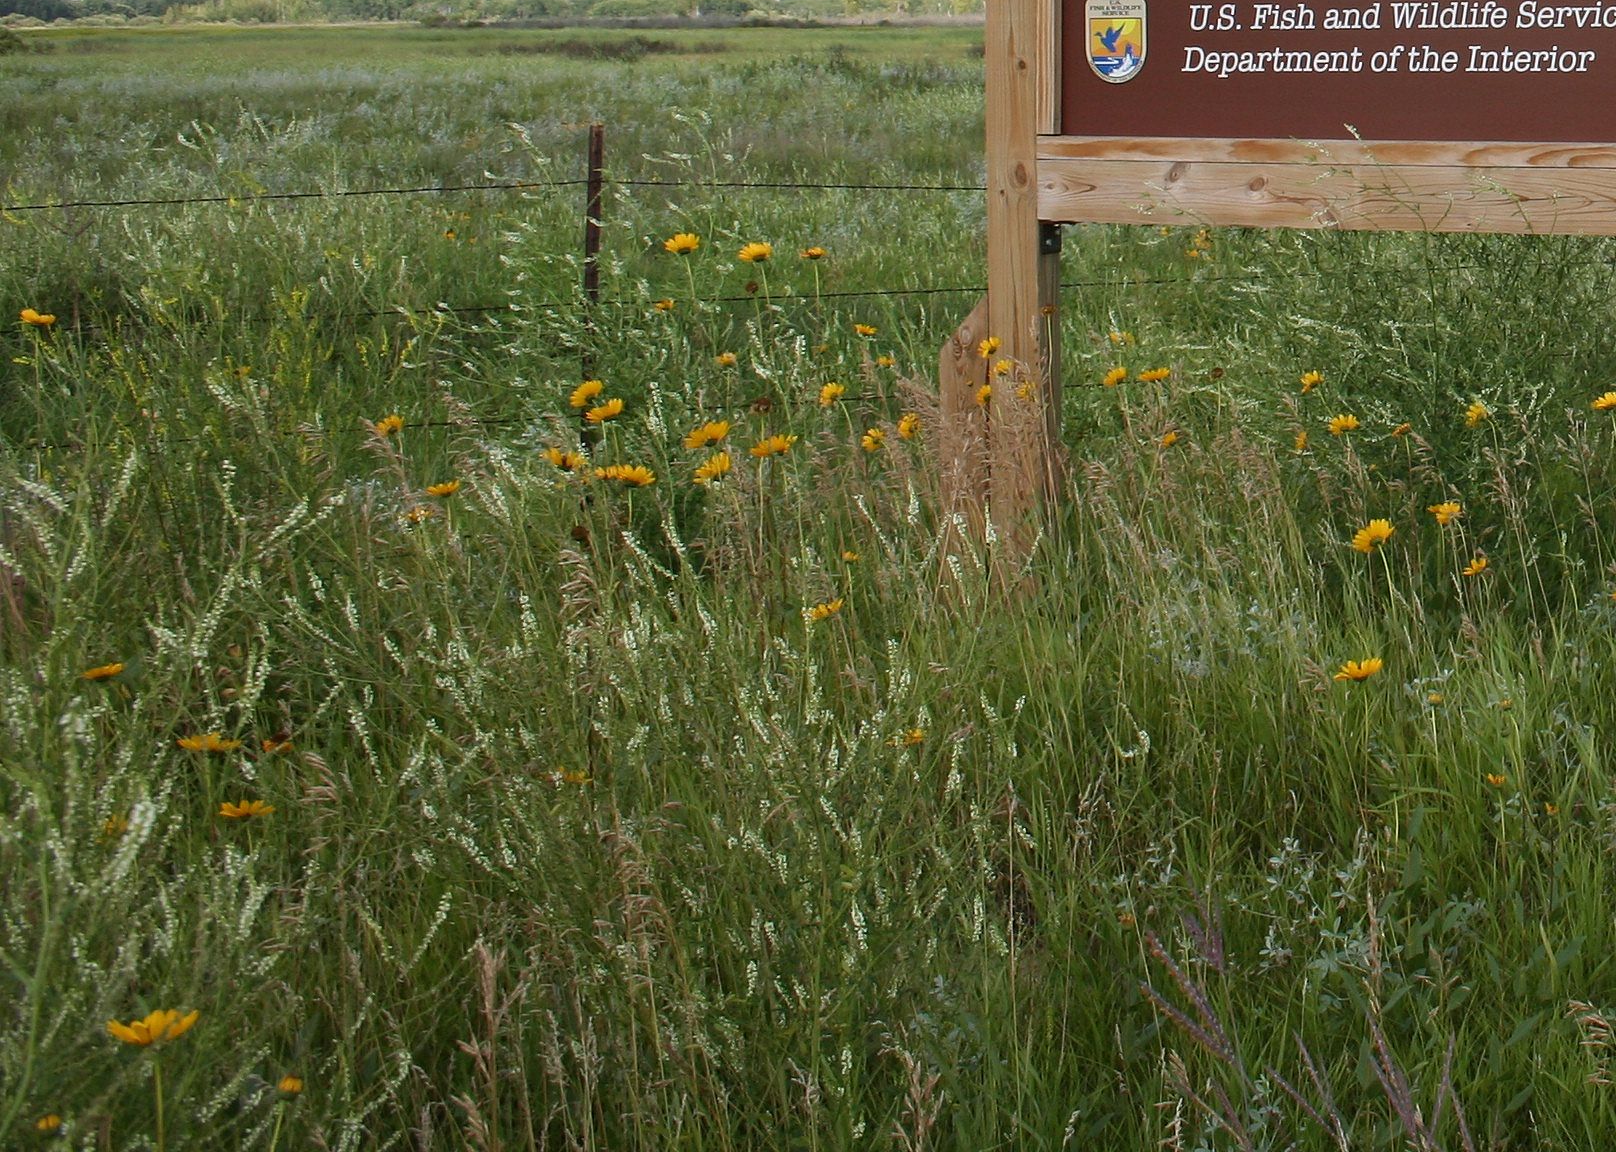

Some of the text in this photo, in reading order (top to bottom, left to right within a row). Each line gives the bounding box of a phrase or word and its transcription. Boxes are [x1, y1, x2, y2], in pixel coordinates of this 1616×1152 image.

[1189, 3, 1242, 31] U.S.
[1249, 3, 1316, 30] Fish
[1323, 2, 1381, 30] and
[1390, 0, 1508, 29] Wildlife
[1181, 45, 1596, 78] Department of the Interior
